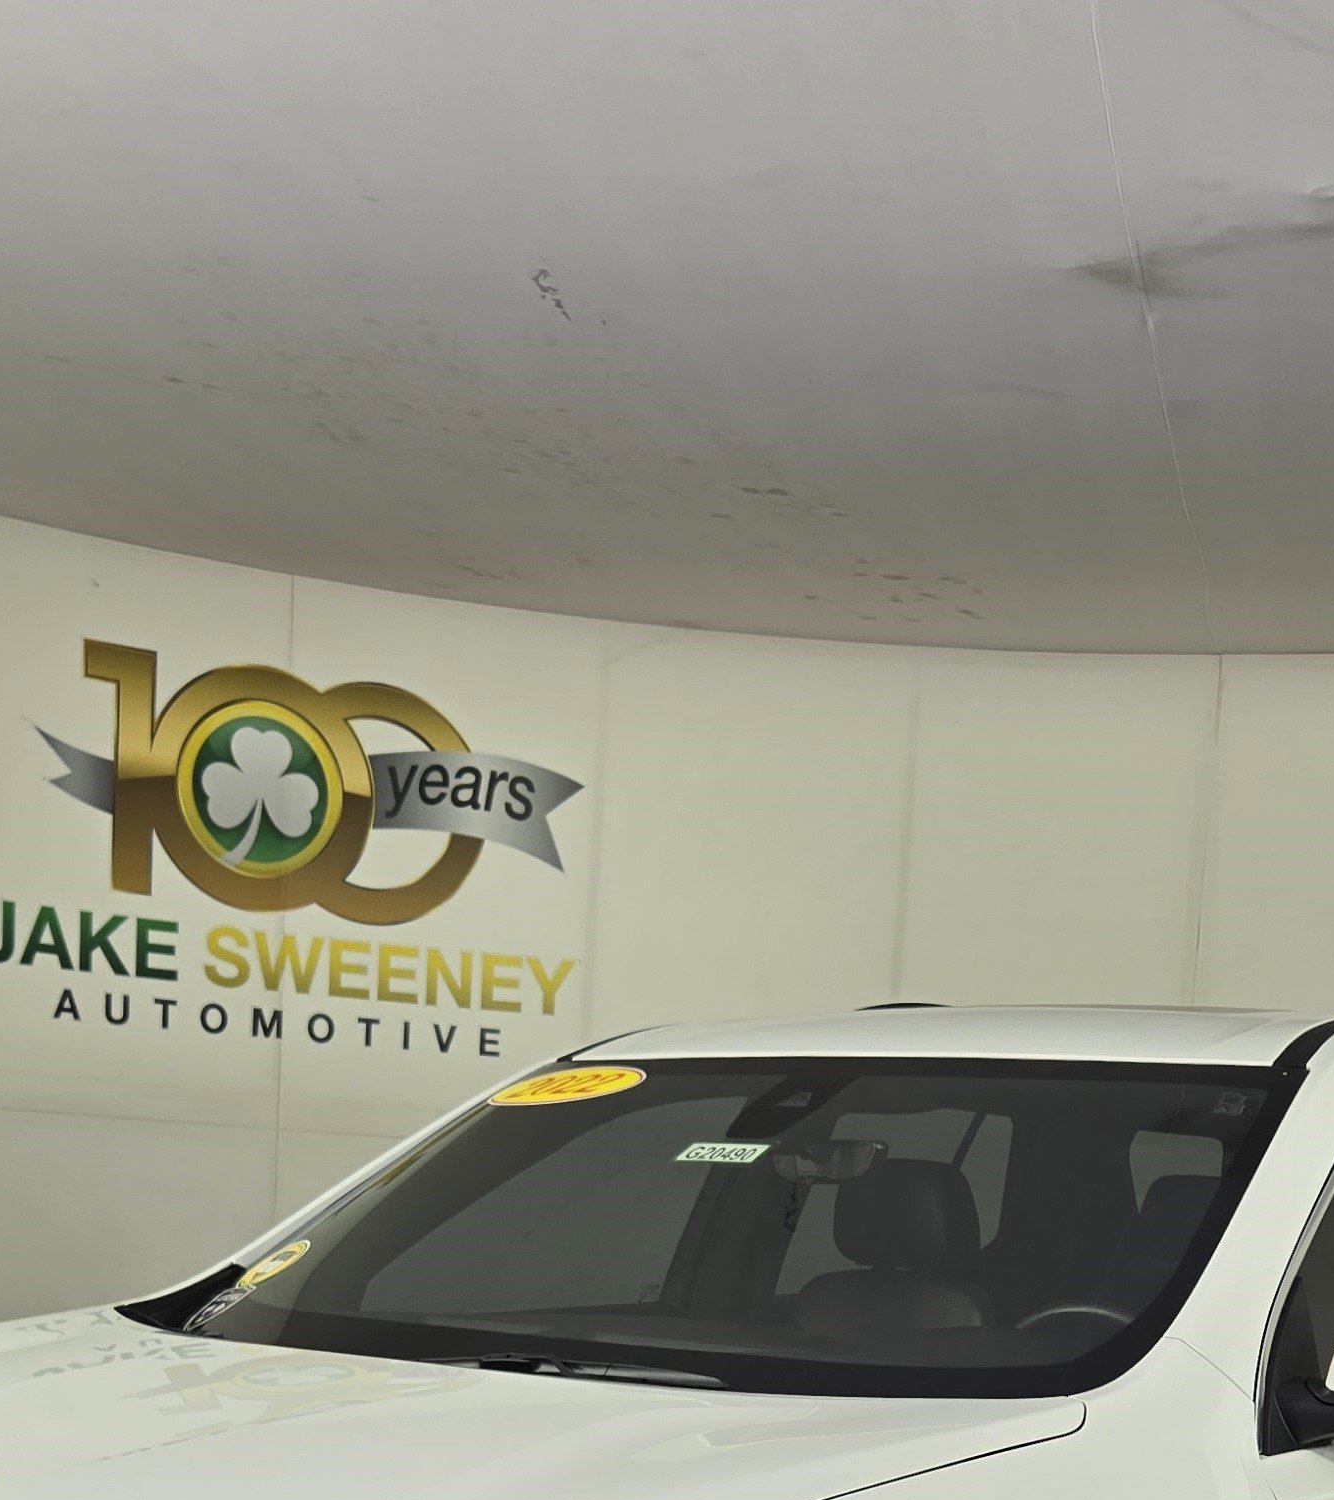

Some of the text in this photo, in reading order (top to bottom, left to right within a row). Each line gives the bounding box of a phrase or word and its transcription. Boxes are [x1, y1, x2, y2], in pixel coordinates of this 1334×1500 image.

[83, 638, 536, 925] 100 years
[204, 925, 579, 1016] SWEENEY
[53, 988, 502, 1058] AUTOMOTIVE
[506, 1073, 626, 1098] 2022
[685, 1146, 757, 1161] G20490
